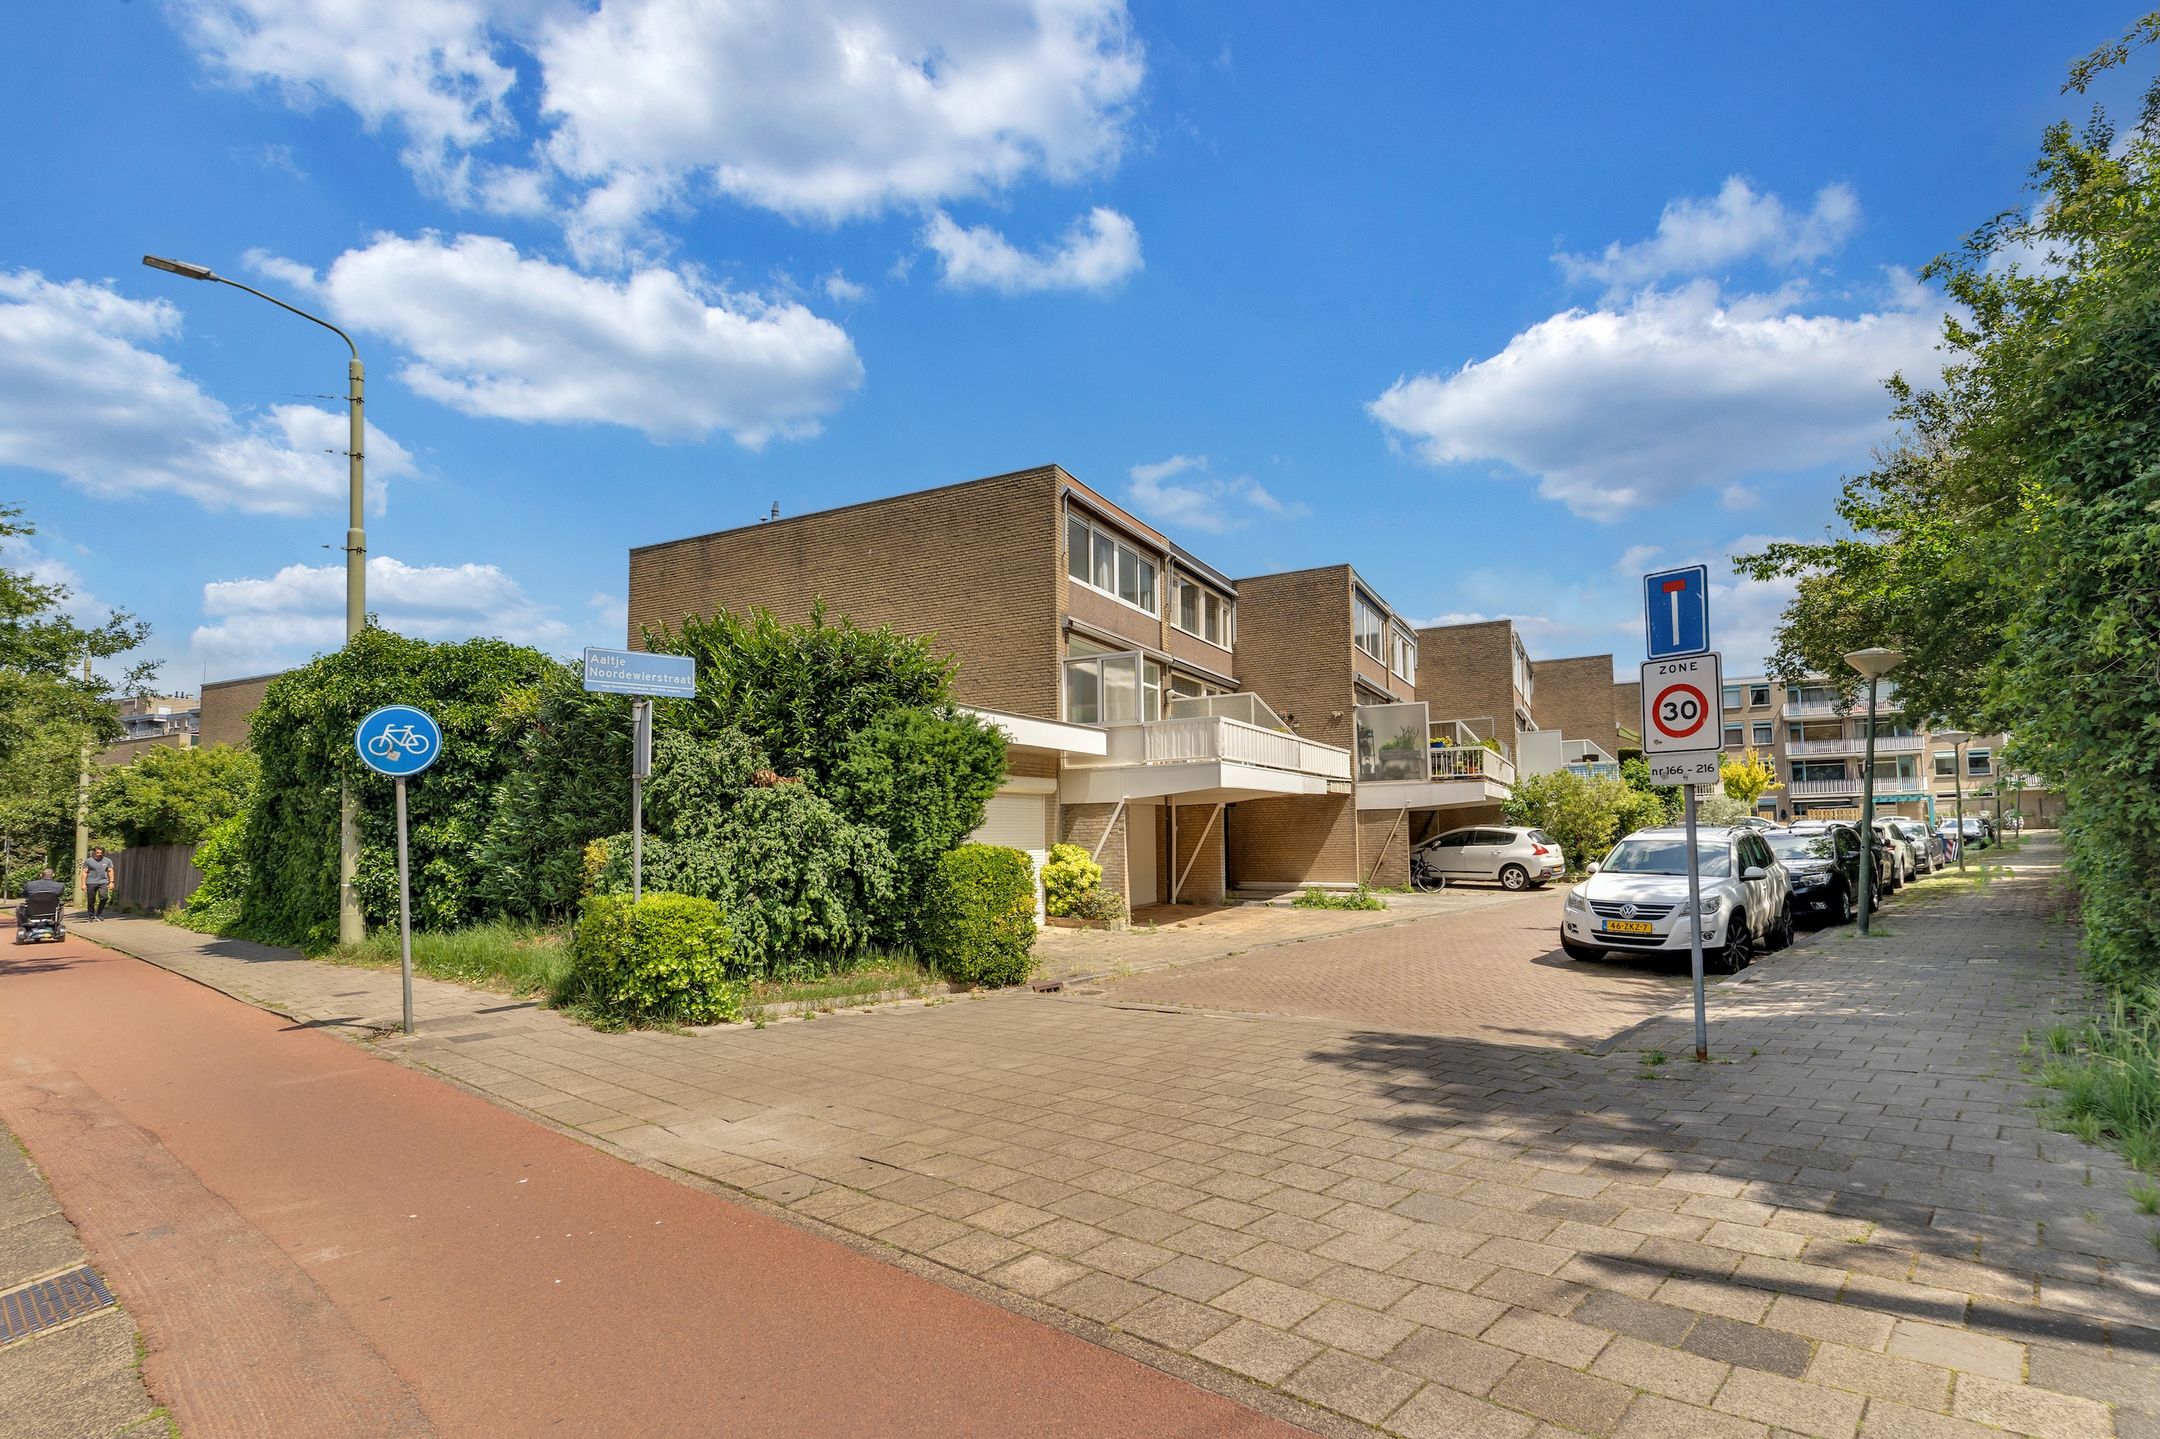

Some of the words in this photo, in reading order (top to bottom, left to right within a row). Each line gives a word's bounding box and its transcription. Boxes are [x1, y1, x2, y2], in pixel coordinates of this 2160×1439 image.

[590, 654, 626, 668] Aaltje
[1659, 662, 1698, 675] ZONE
[589, 667, 692, 685] Noordewierstraat
[1663, 700, 1698, 721] 30
[1666, 765, 1684, 775] 166
[1696, 763, 1715, 774] 216
